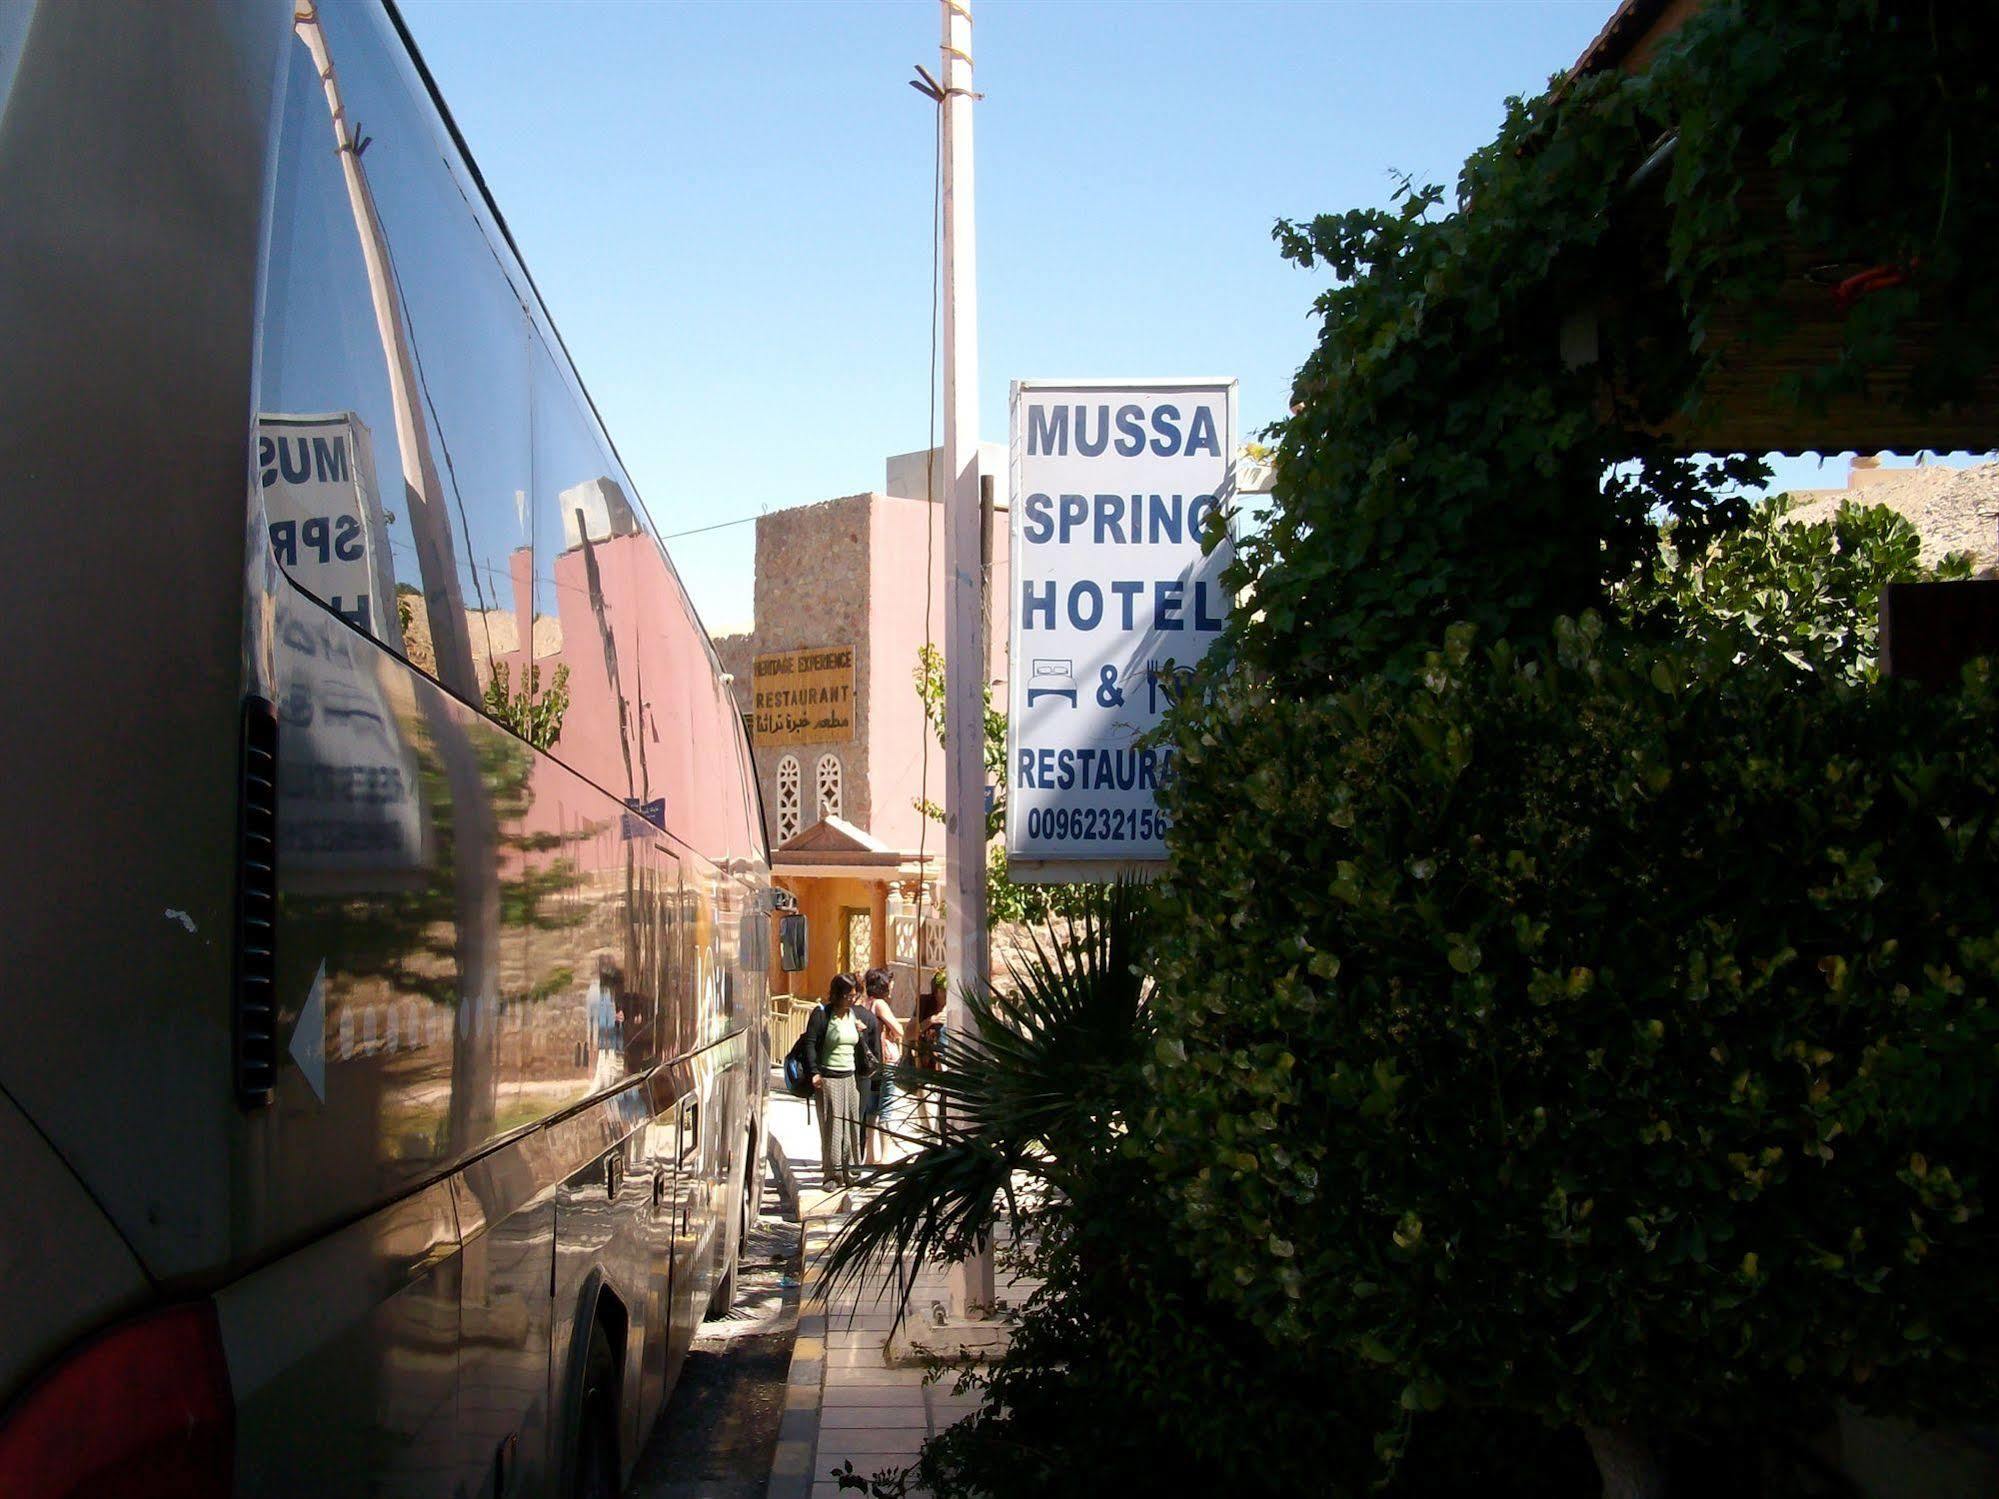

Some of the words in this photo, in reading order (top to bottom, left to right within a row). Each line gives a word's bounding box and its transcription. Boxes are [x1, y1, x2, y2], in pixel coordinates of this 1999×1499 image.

[1027, 404, 1221, 457] MUSSA
[1022, 580, 1222, 631] HOTEL
[798, 651, 852, 673] EXPERIENCE
[756, 685, 849, 708] RESTAURANT
[1096, 664, 1125, 708] &
[813, 709, 849, 729] مطعم
